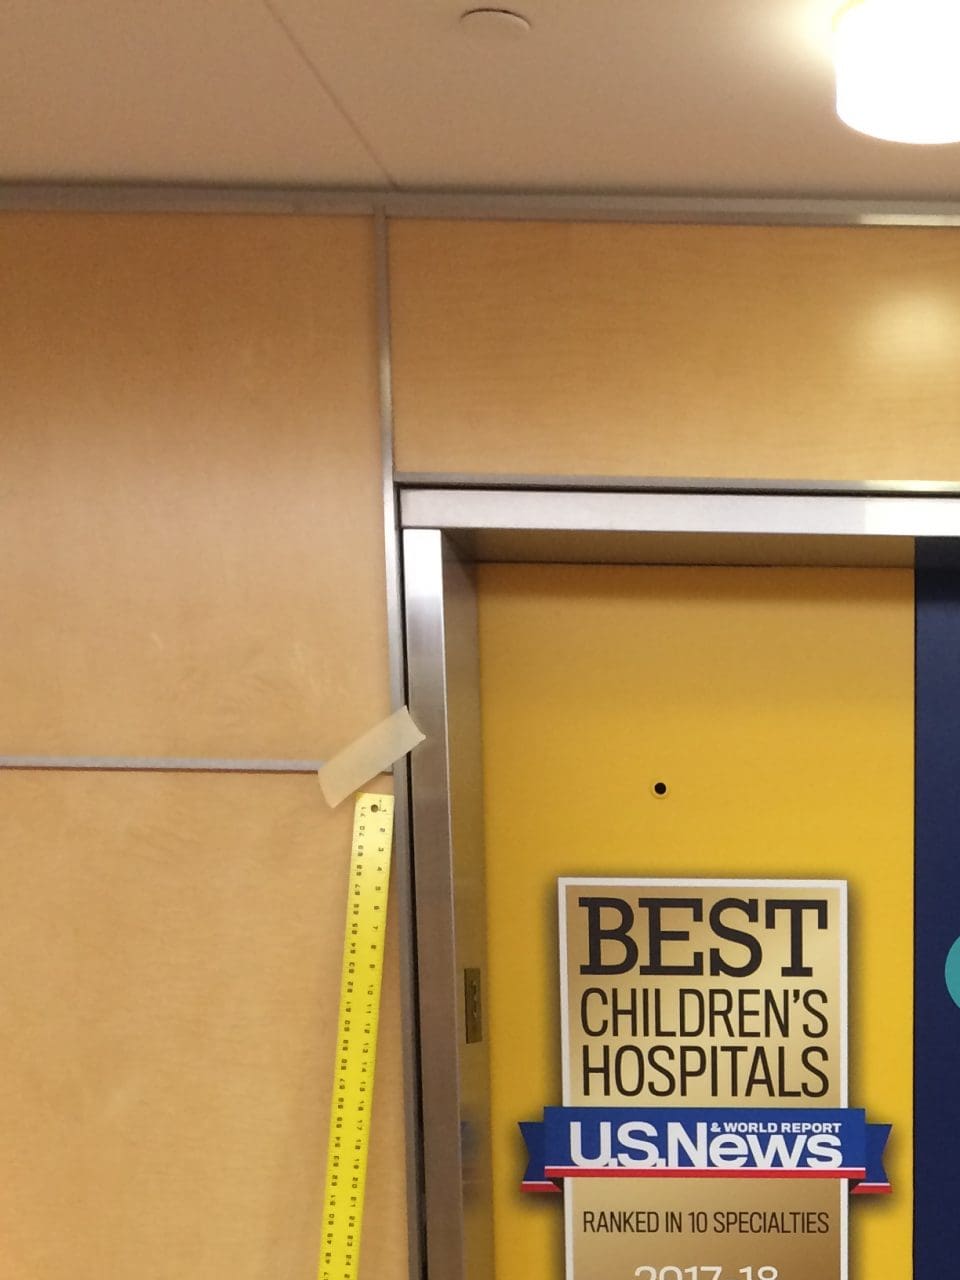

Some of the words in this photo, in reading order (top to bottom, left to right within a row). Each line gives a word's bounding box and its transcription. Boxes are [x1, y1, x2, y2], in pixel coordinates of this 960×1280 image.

[578, 896, 829, 977] BEST
[579, 987, 830, 1039] CHILDREN'S
[581, 1044, 830, 1098] HOSPITALS
[726, 1122, 777, 1134] WORLD
[781, 1122, 842, 1134] REPORT
[582, 1210, 659, 1234] RANKED
[664, 1211, 683, 1233] IN
[688, 1211, 708, 1234] 10
[713, 1211, 830, 1234] SPECIALTIES
